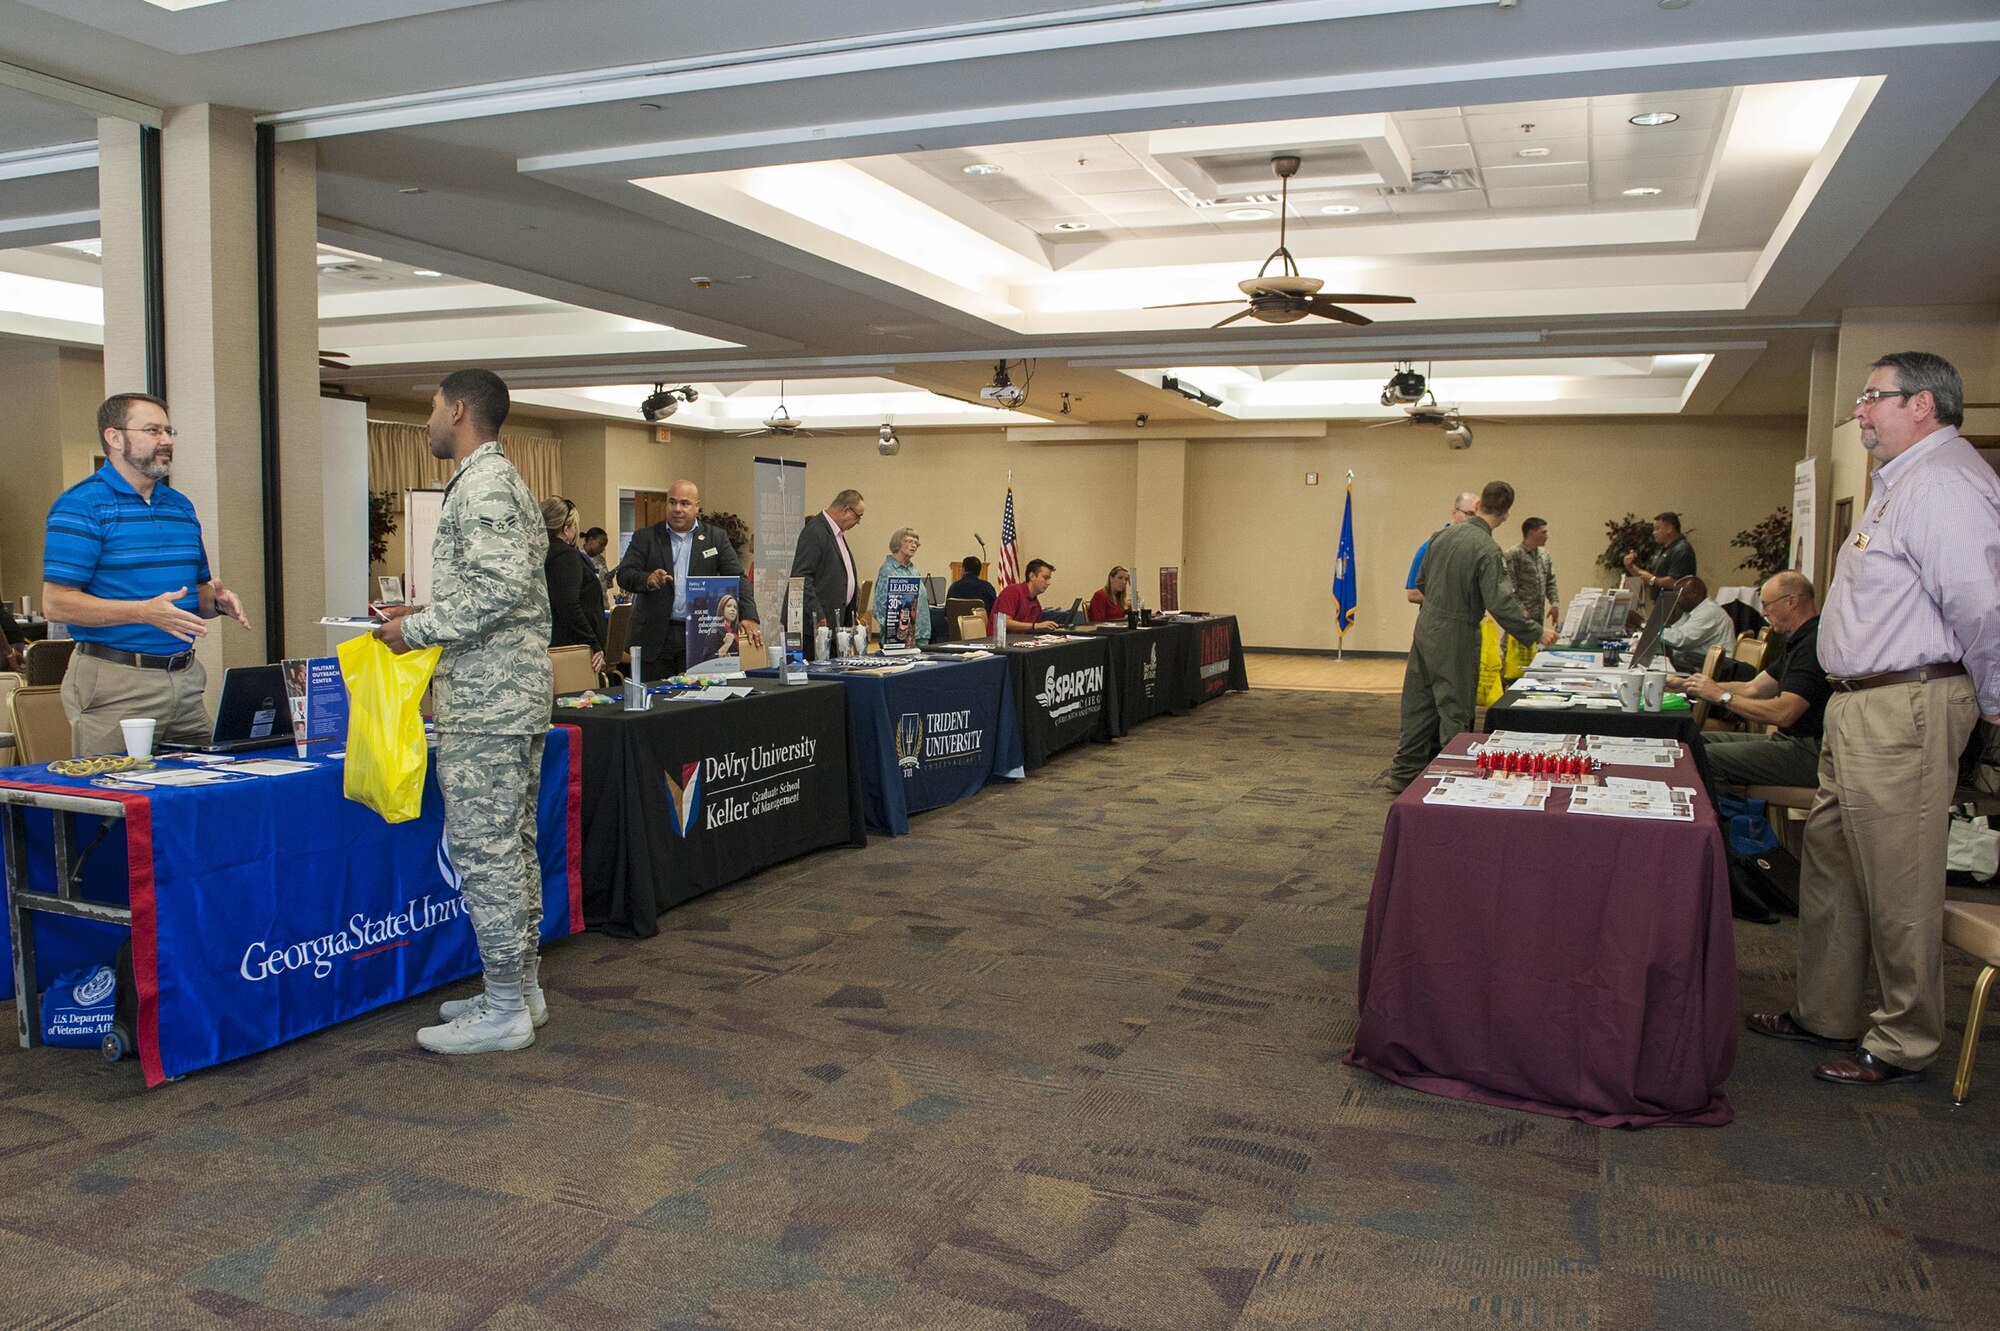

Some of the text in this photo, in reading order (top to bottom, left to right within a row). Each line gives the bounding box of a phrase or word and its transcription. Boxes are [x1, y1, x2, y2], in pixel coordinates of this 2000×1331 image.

[890, 584, 918, 592] LEADERS
[1055, 665, 1103, 703] SPARTAN
[926, 710, 970, 733] TRIDENT
[925, 730, 983, 757] UNIVERSITY
[705, 736, 816, 783] DeVry University
[752, 778, 800, 803] Graduate School
[706, 797, 750, 830] Keller
[752, 791, 800, 815] of Management
[48, 1026, 56, 1035] of
[56, 1025, 93, 1035] Veterans
[53, 1014, 68, 1023] U.S.
